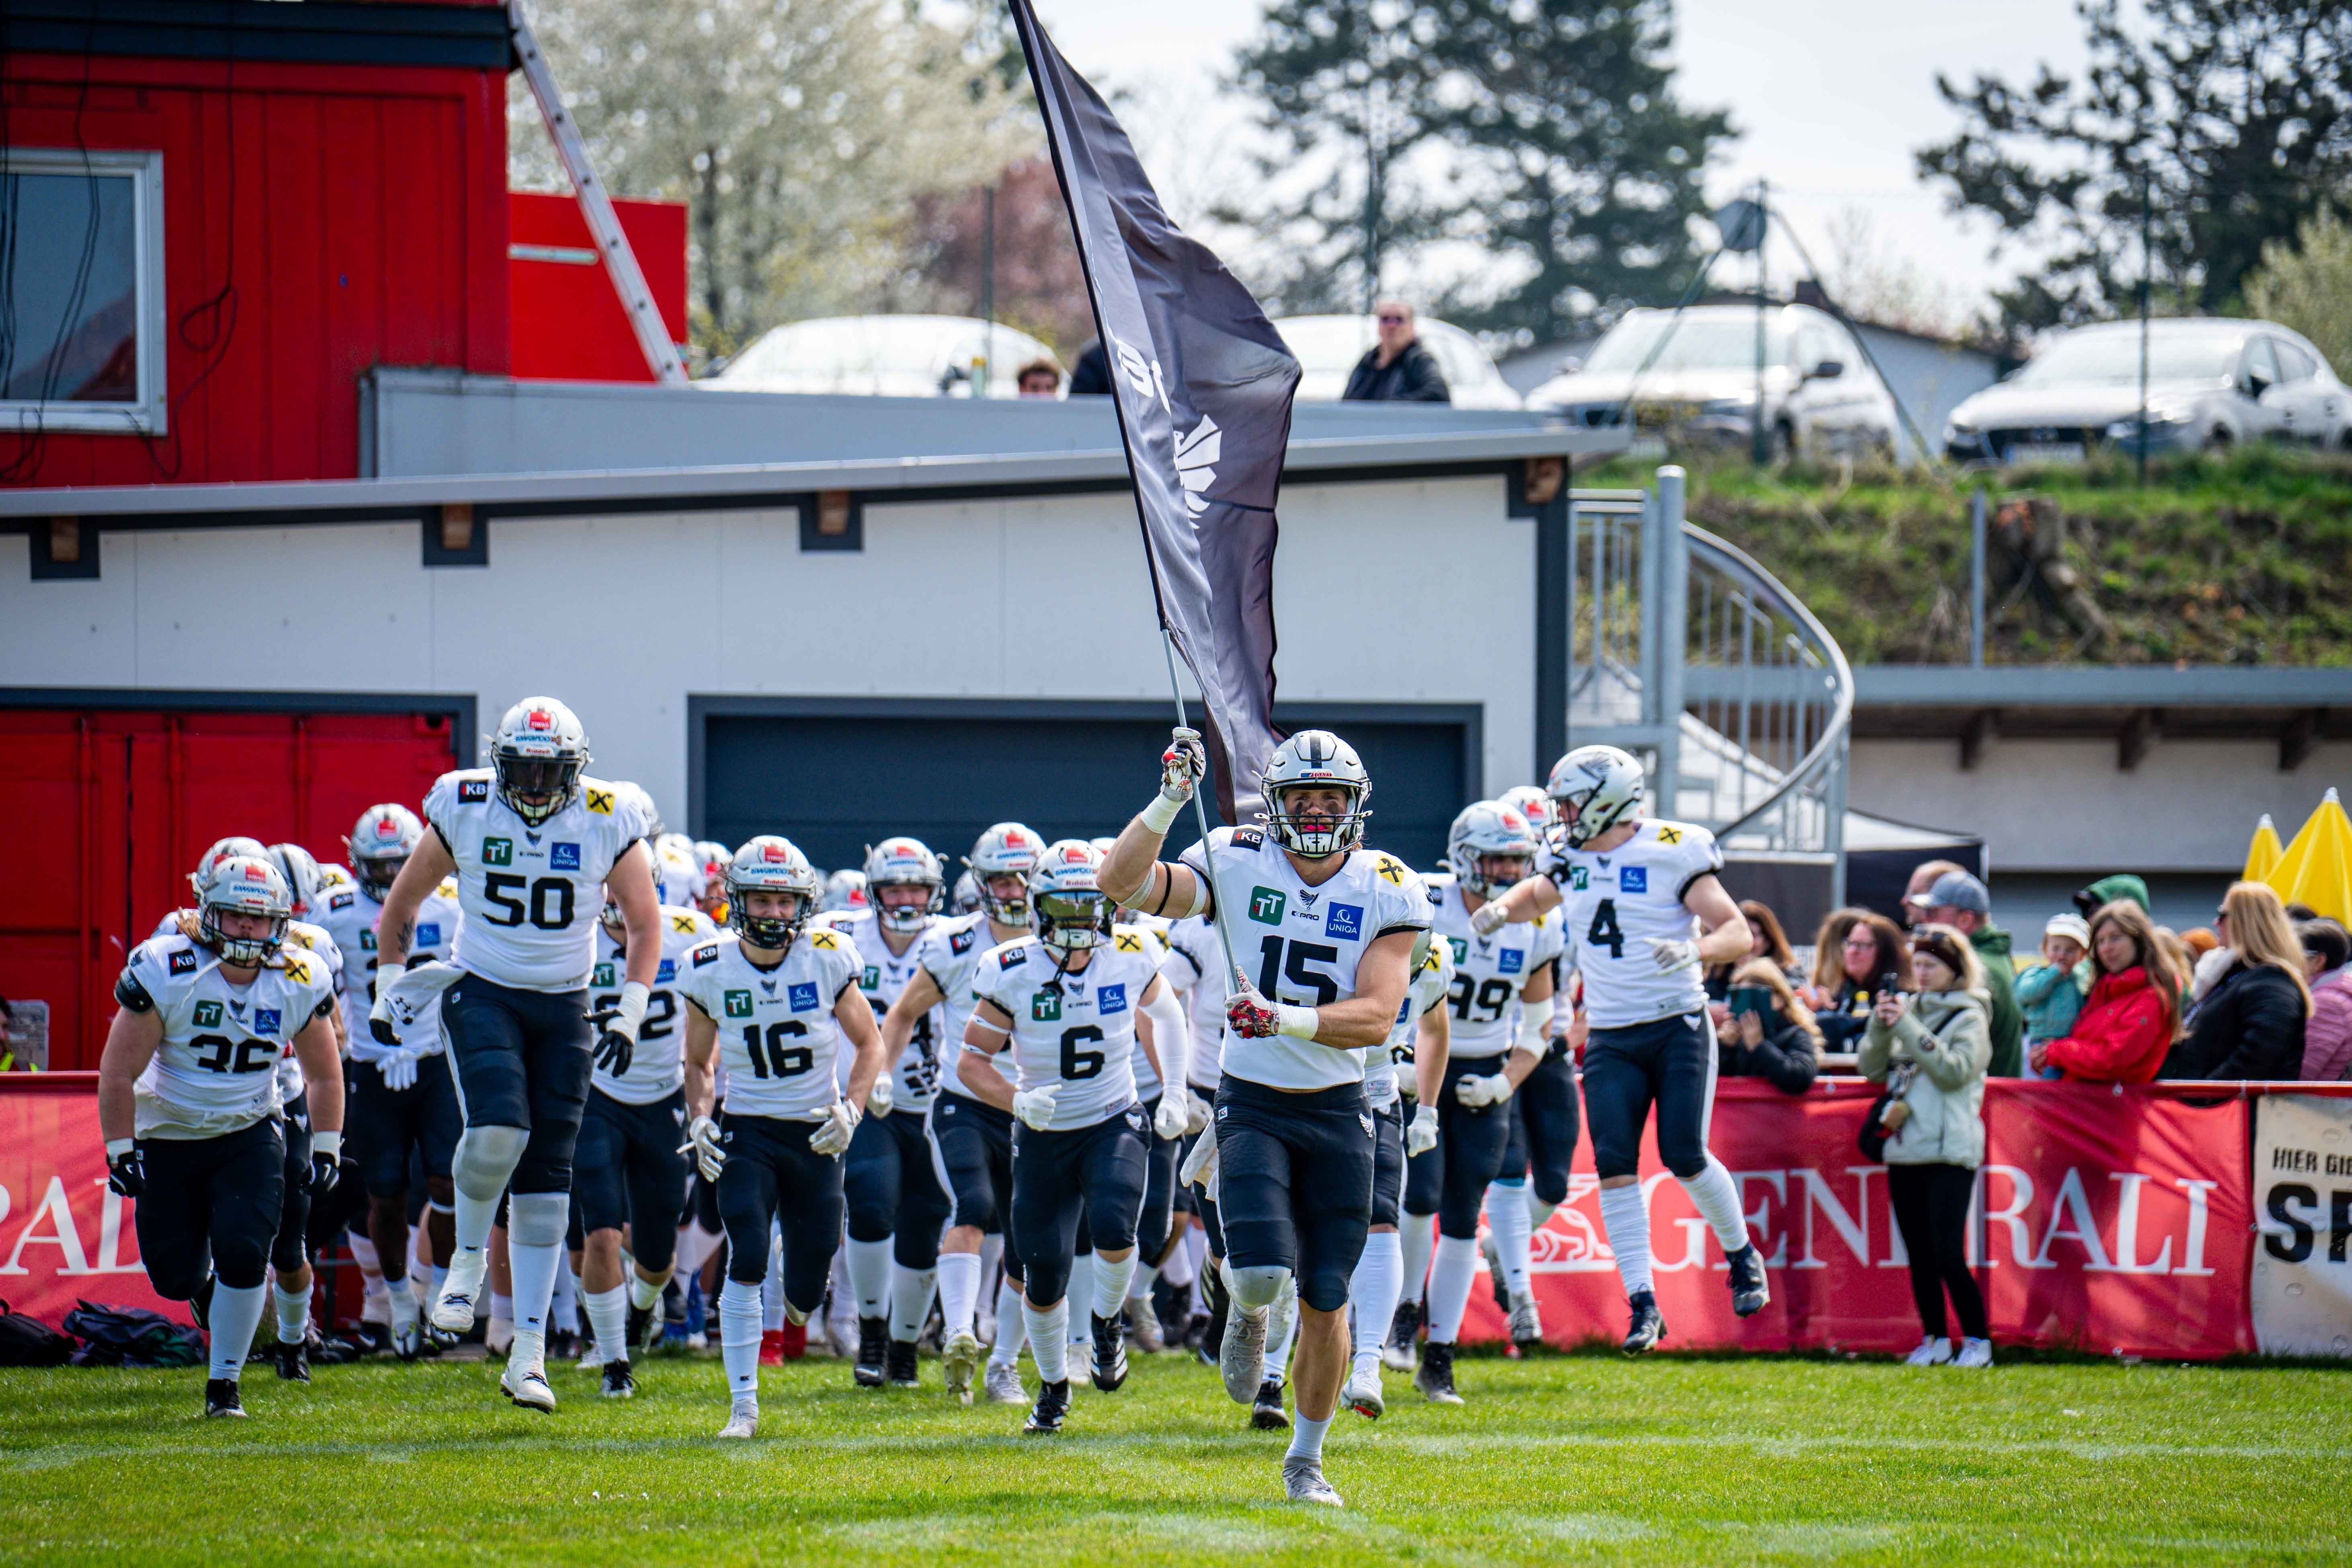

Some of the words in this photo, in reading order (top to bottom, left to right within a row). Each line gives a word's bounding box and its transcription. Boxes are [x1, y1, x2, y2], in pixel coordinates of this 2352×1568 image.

[553, 858, 578, 866] UNIQA
[482, 871, 575, 930] 50
[1329, 923, 1357, 934] UNIQA
[1588, 898, 1624, 959] 4
[1259, 935, 1338, 1007] 15
[793, 999, 817, 1007] UNIQA
[1101, 1000, 1125, 1010] UNIQA
[744, 1019, 815, 1079] 16
[1060, 1024, 1105, 1081] 6
[2273, 1147, 2318, 1172] HIER
[1640, 1164, 2218, 1277] GENRALI
